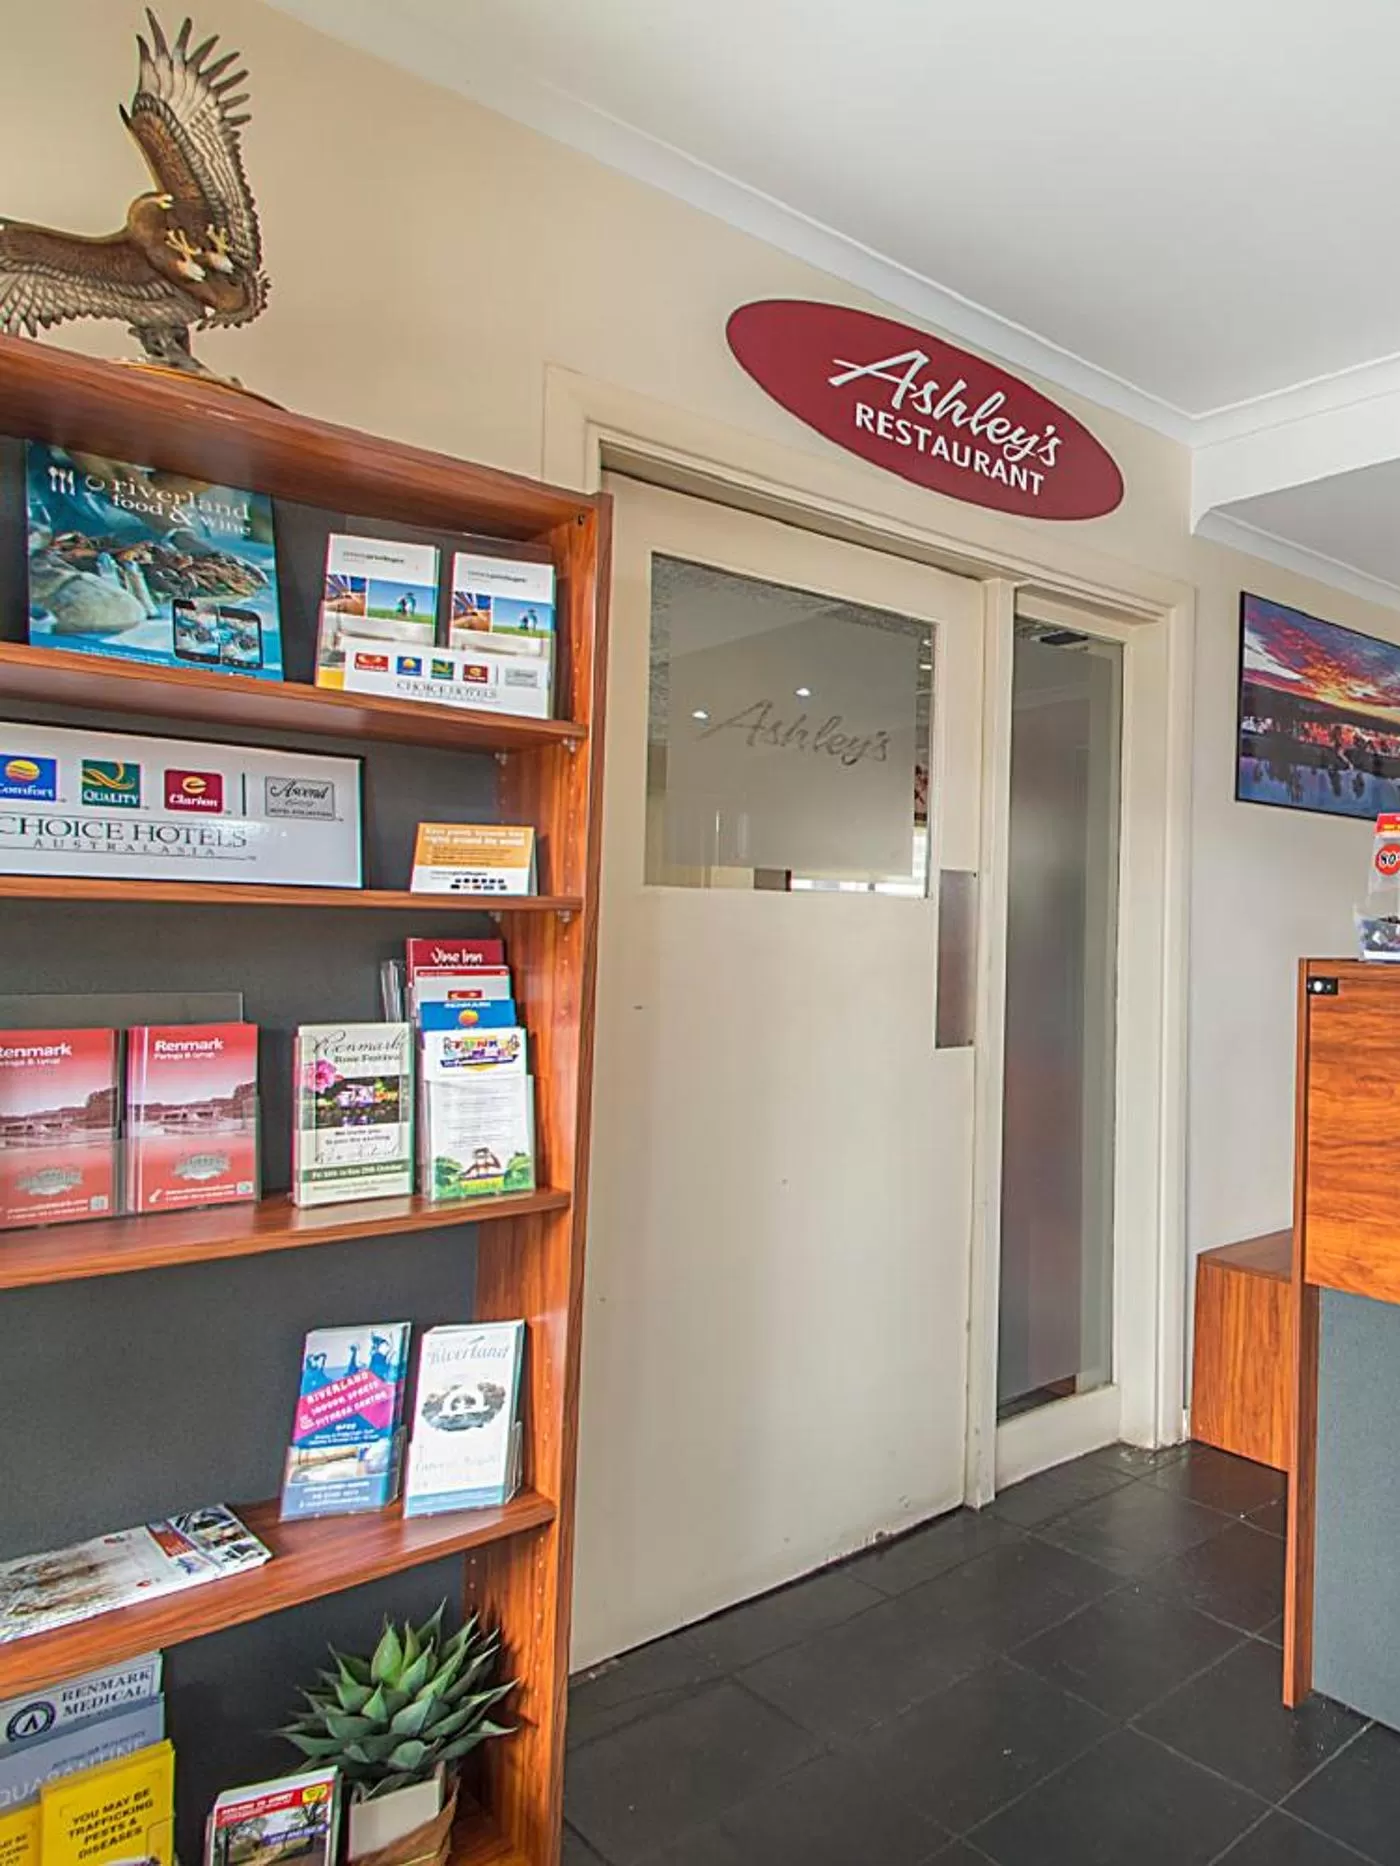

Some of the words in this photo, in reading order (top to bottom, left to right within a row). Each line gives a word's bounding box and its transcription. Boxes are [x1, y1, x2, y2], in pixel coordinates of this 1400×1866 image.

[828, 349, 1062, 468] Ashley's
[855, 402, 1044, 496] RESTAURANT
[112, 477, 250, 520] riverland
[112, 493, 163, 516] food
[169, 505, 193, 527] &
[698, 699, 891, 766] Ashley's
[83, 789, 139, 805] QUALITY
[169, 793, 218, 808] Clarion
[0, 815, 124, 840] CHOICE
[132, 823, 248, 848] HOTELS
[33, 837, 216, 856] AUSTRALASIA
[431, 946, 460, 963] Vine
[461, 948, 484, 963] Inn
[154, 1037, 224, 1053] Renmark
[62, 1670, 150, 1702] RENMARK
[62, 1686, 147, 1717] MEDICAL
[69, 1799, 154, 1838] TRAFFICKING
[72, 1808, 99, 1825] YOU
[102, 1796, 130, 1813] MAY
[133, 1787, 151, 1801] BE
[78, 1826, 143, 1860] DISEASES
[83, 1822, 125, 1844] PESTS
[129, 1816, 137, 1825] &
